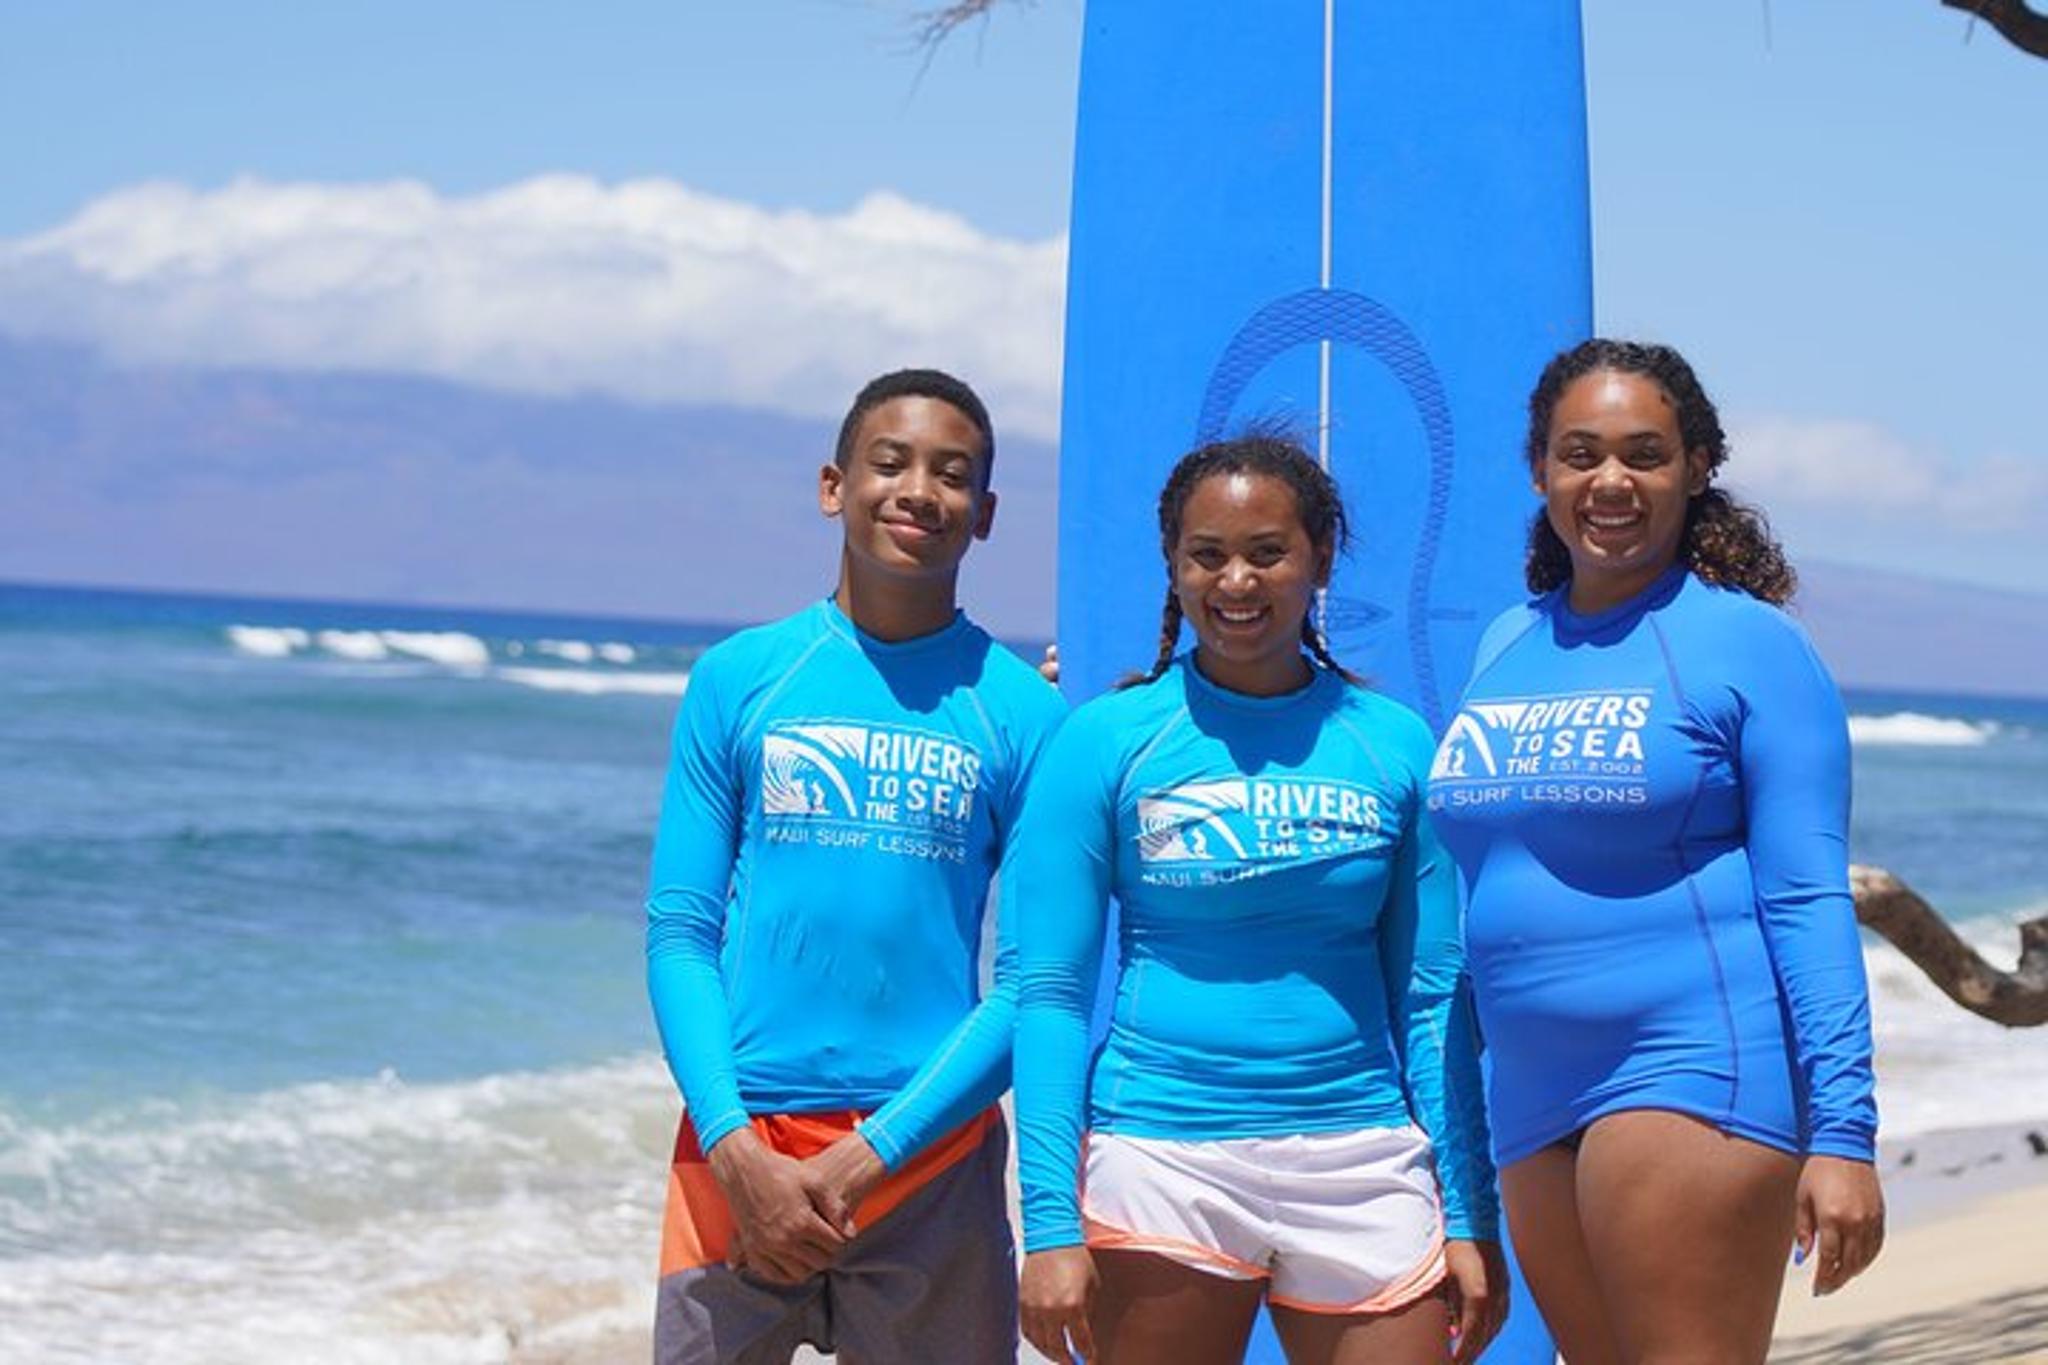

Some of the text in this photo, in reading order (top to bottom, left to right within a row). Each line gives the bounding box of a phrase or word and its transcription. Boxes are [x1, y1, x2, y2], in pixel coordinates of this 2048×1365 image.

[1518, 695, 1650, 733] RIVERS
[1512, 728, 1644, 760] TO SEA
[869, 732, 981, 791] RIVERS
[1506, 755, 1542, 775] THE
[867, 775, 974, 822] TO SEA
[1254, 783, 1382, 829] RIVERS
[1452, 786, 1513, 806] SURF
[1520, 783, 1648, 804] LESSONS
[864, 801, 899, 822] THE
[1255, 819, 1296, 839] TO
[765, 826, 966, 865] MAUI SURF LESSONS
[1256, 841, 1301, 857] THE
